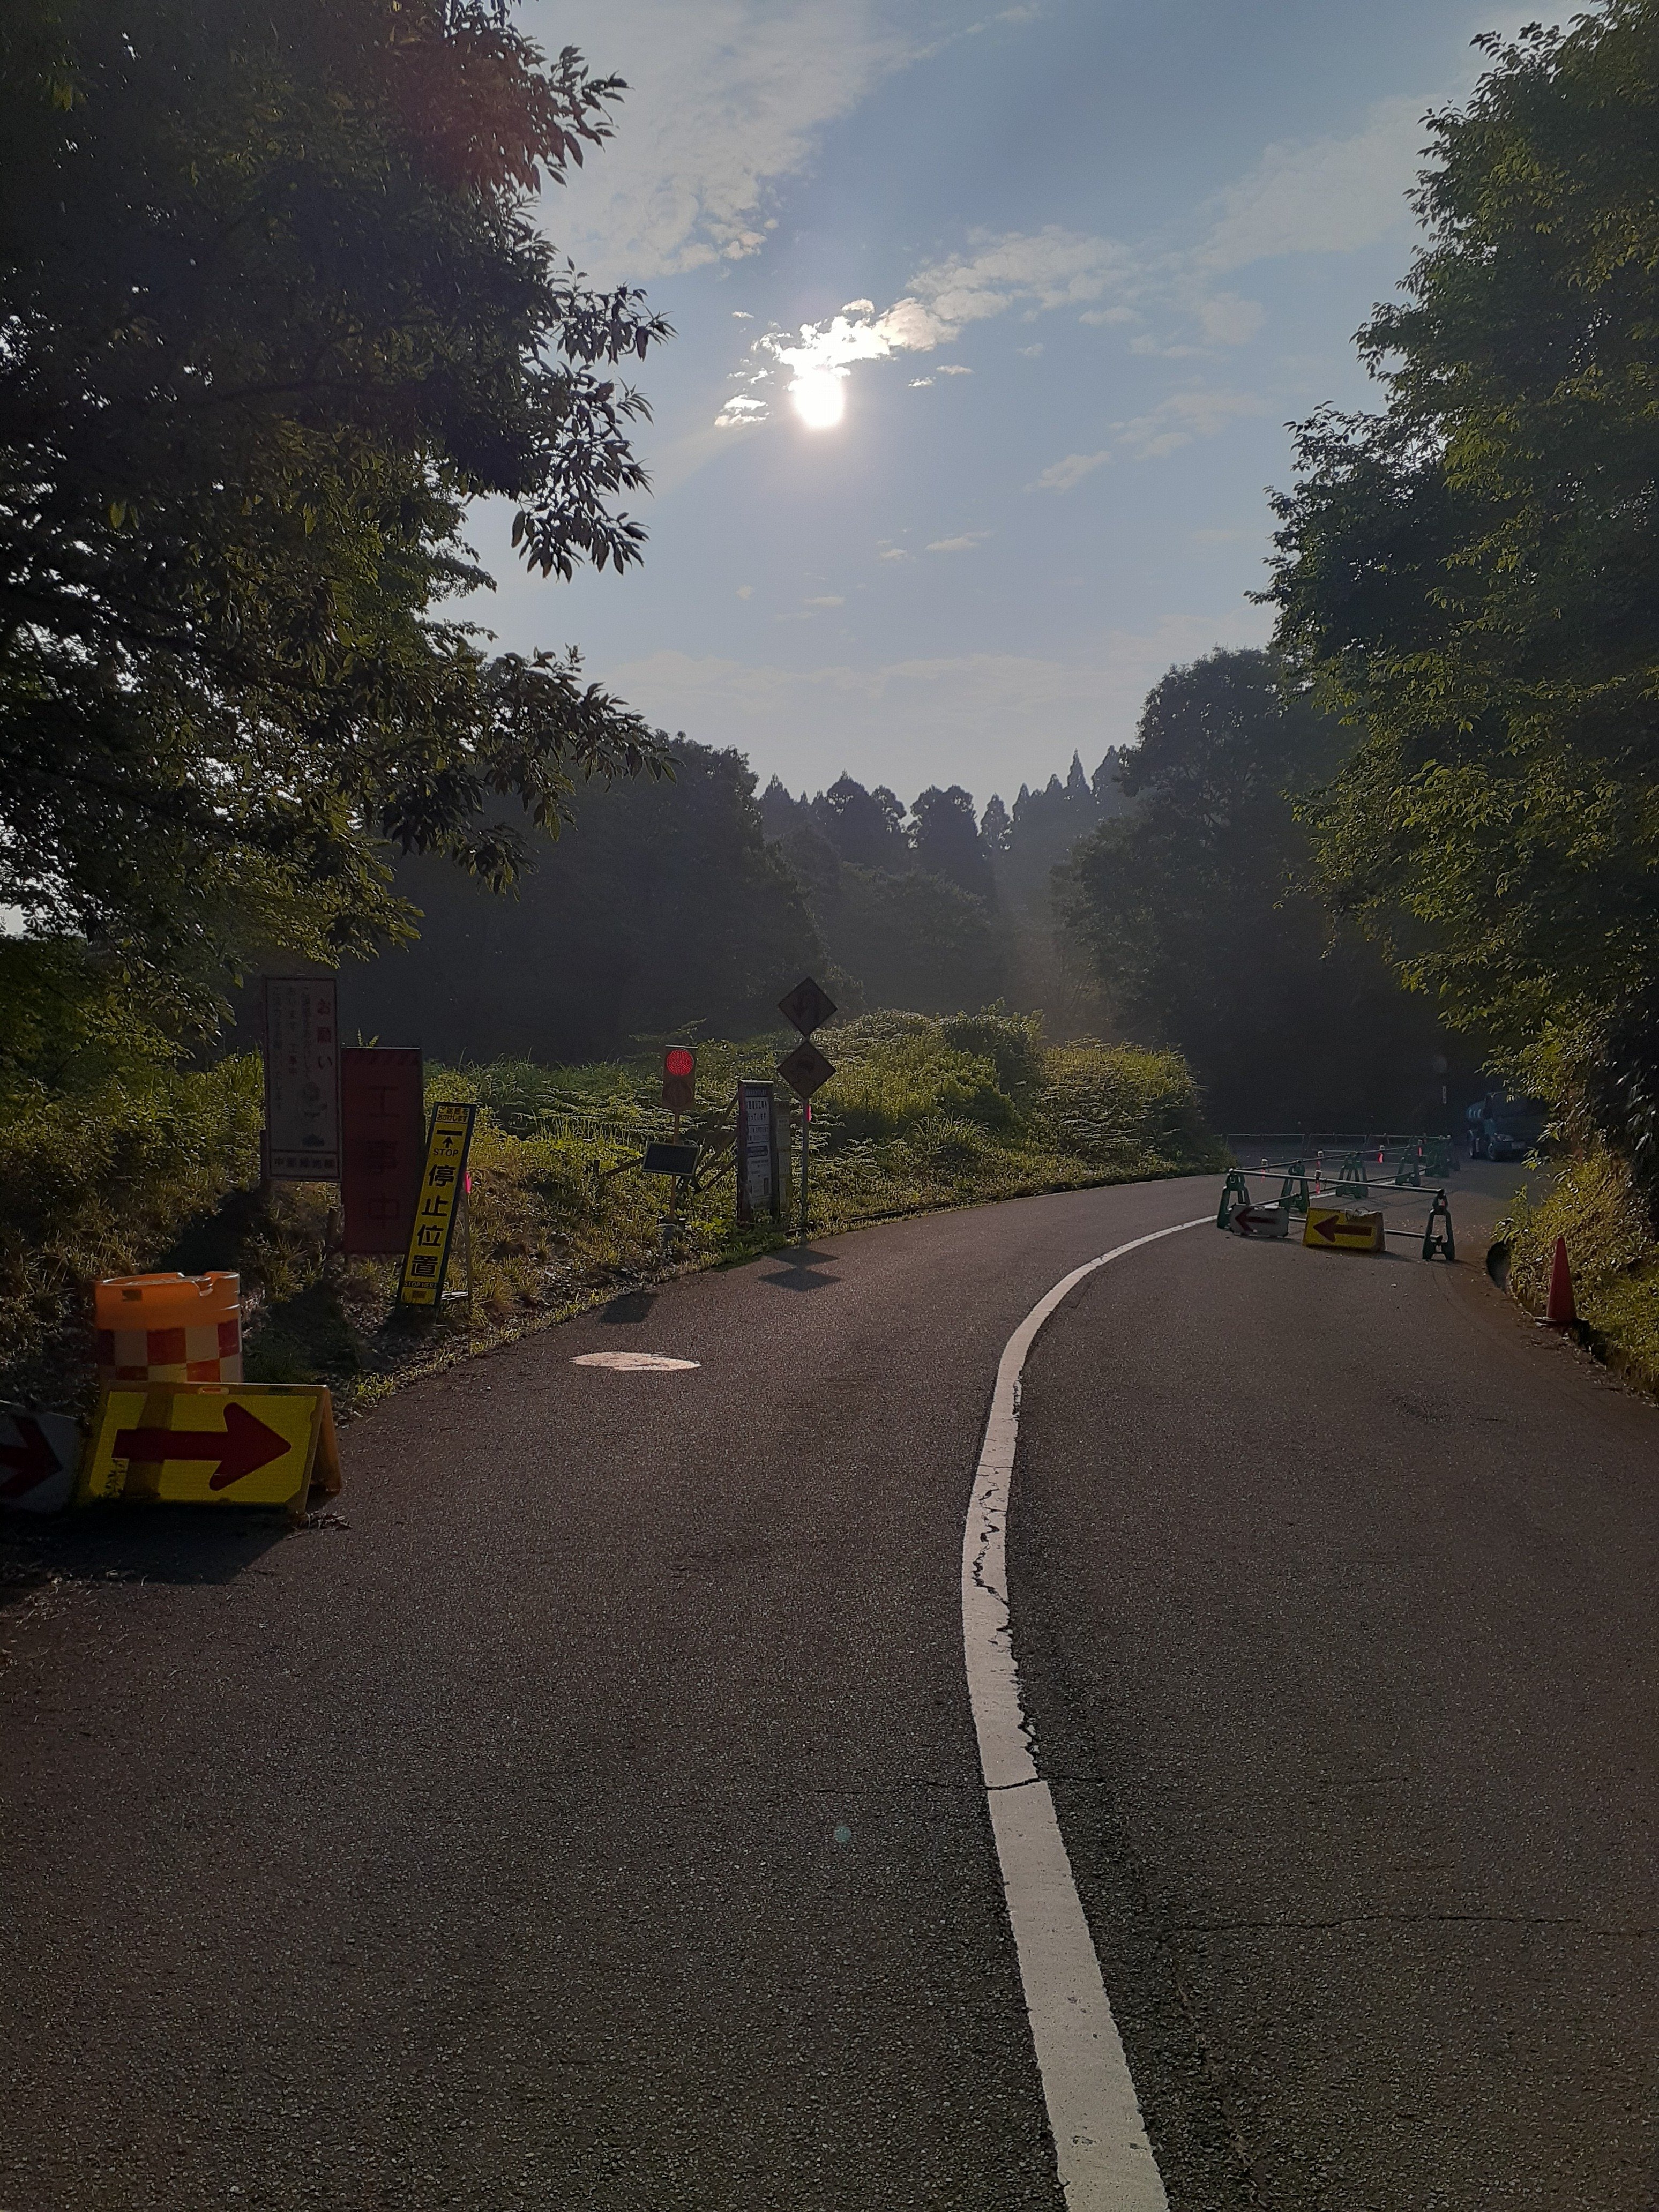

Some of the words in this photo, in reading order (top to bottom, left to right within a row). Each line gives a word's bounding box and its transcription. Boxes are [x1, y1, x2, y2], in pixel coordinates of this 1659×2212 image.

[317, 998, 333, 1070] お願い
[438, 1107, 469, 1115] ご迷惑を
[366, 1085, 401, 1230] 工事中
[433, 1148, 459, 1156] STOP
[411, 1164, 456, 1277] 停止位置
